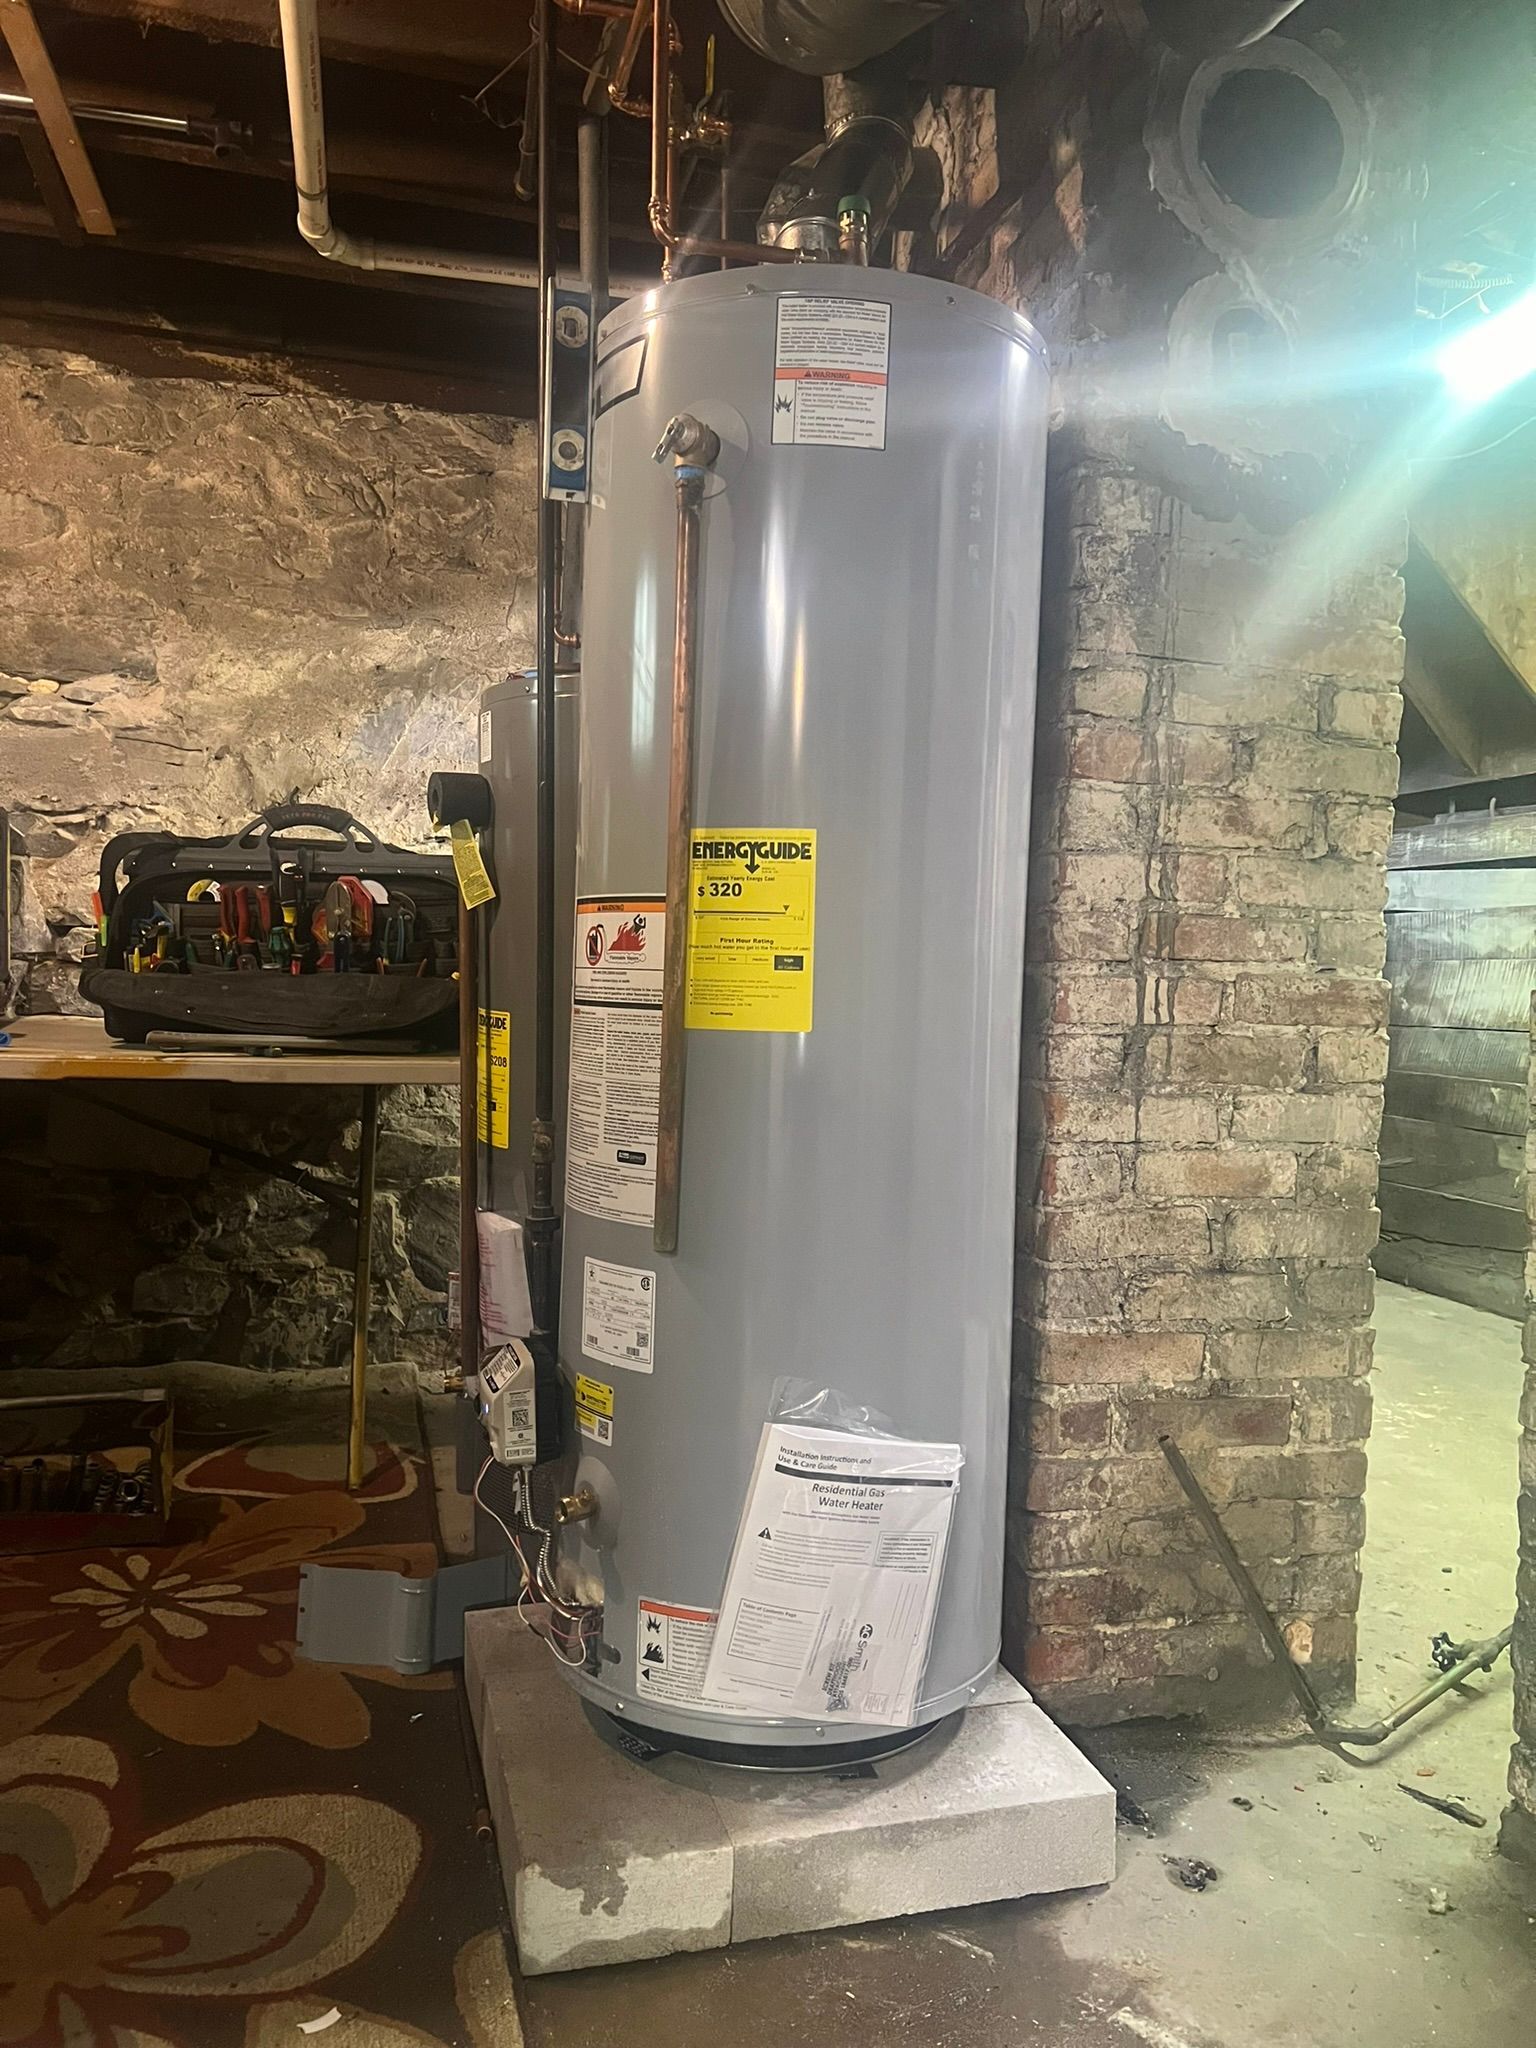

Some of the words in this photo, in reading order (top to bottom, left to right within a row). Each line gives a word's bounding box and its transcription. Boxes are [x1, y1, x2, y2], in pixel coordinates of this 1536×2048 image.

[812, 371, 850, 379] WARNING
[692, 841, 812, 860] ENERGYGUIDE
[697, 885, 705, 897] $
[709, 882, 742, 897] 320
[602, 904, 624, 912] WARNING
[778, 1454, 791, 1464] Use
[800, 1460, 816, 1469] Care
[818, 1462, 838, 1471] Guide
[780, 1446, 819, 1461] Installation
[820, 1454, 858, 1464] Instructions
[859, 1457, 872, 1465] and
[812, 1483, 867, 1497] Residential
[868, 1488, 886, 1498] Gas
[819, 1496, 850, 1509] Water
[852, 1501, 884, 1511] Heater
[849, 1640, 868, 1672] Smith
[822, 1671, 833, 1692] SCREW
